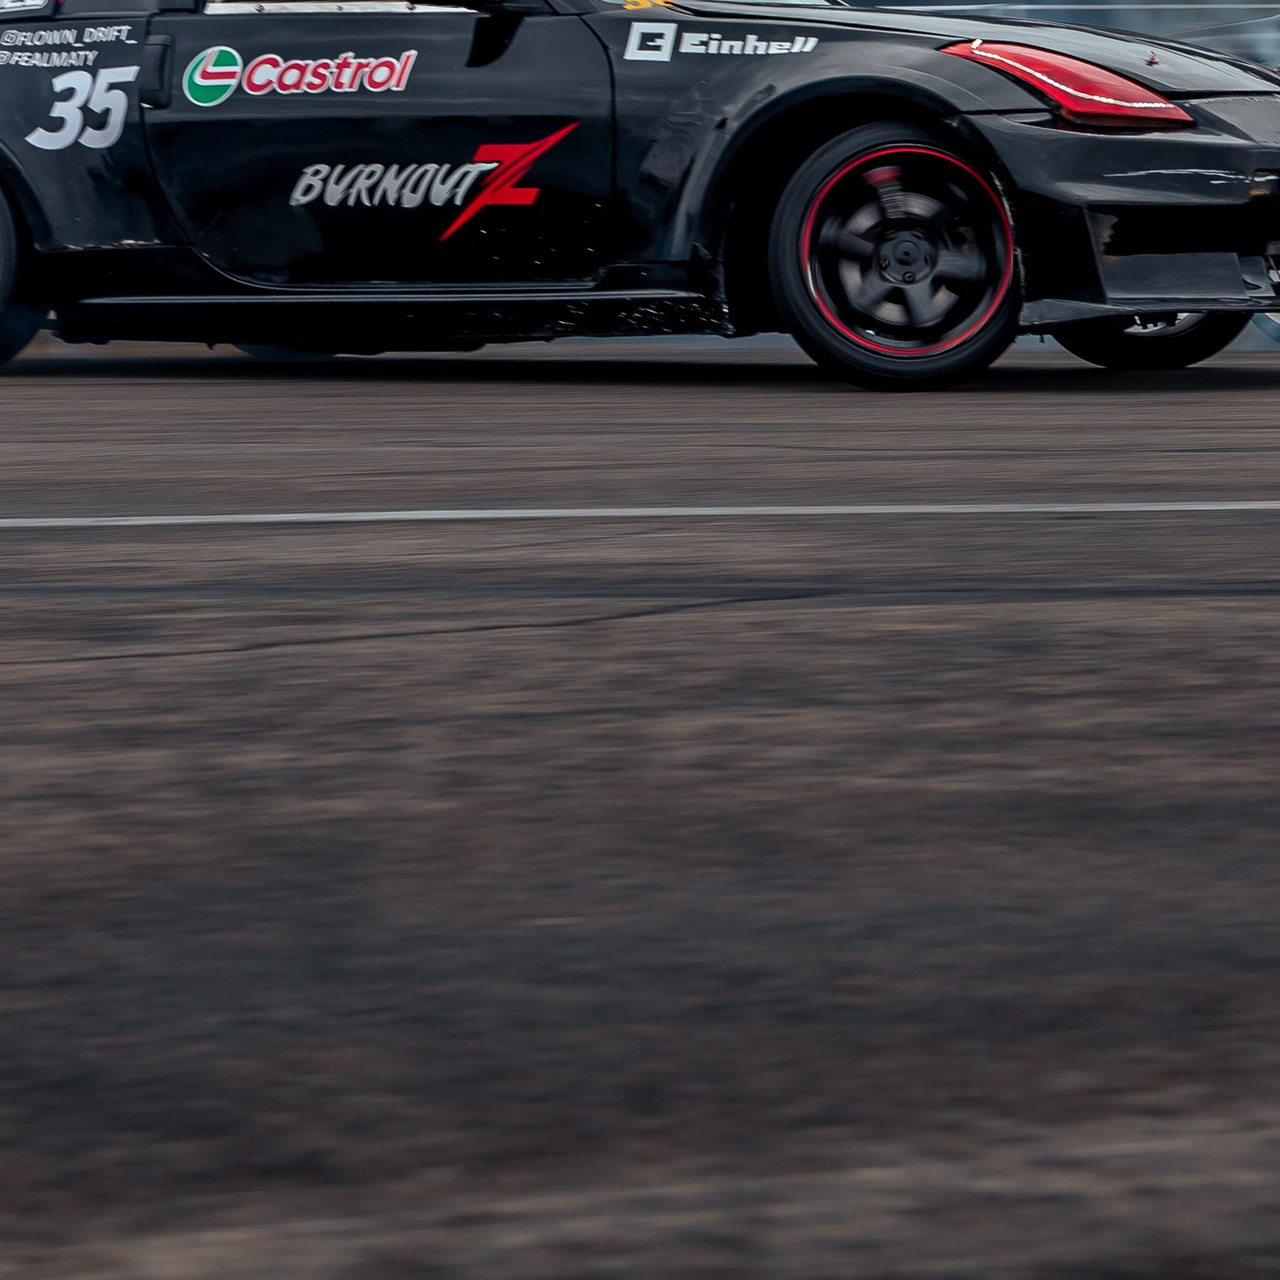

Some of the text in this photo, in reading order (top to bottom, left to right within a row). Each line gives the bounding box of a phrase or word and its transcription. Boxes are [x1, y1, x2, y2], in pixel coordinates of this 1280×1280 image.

[678, 32, 819, 55] Einhell
[241, 49, 418, 96] Castrol
[24, 65, 141, 151] 35
[289, 163, 500, 208] BURNOUT
